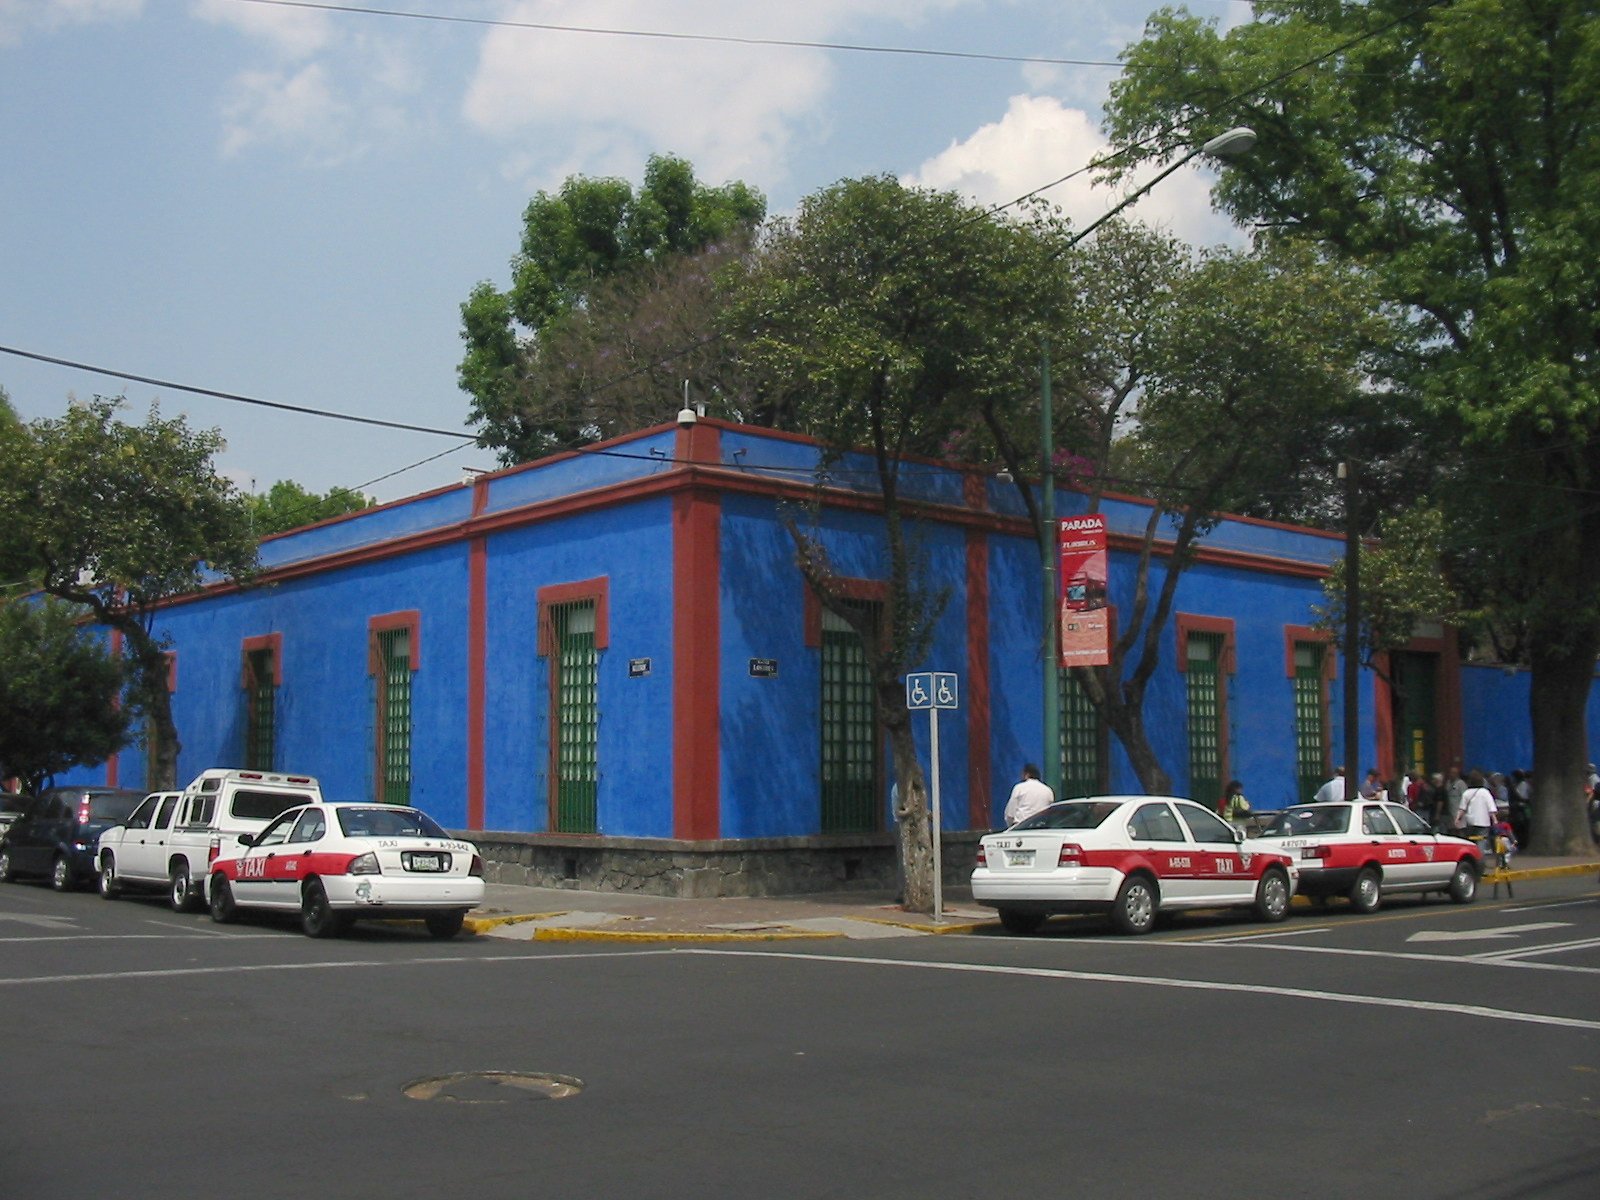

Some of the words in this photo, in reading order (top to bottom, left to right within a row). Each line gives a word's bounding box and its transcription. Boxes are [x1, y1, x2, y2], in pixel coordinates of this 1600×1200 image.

[1061, 519, 1103, 531] PARADA
[245, 858, 266, 877] TAXI
[1215, 858, 1233, 873] TAXI
